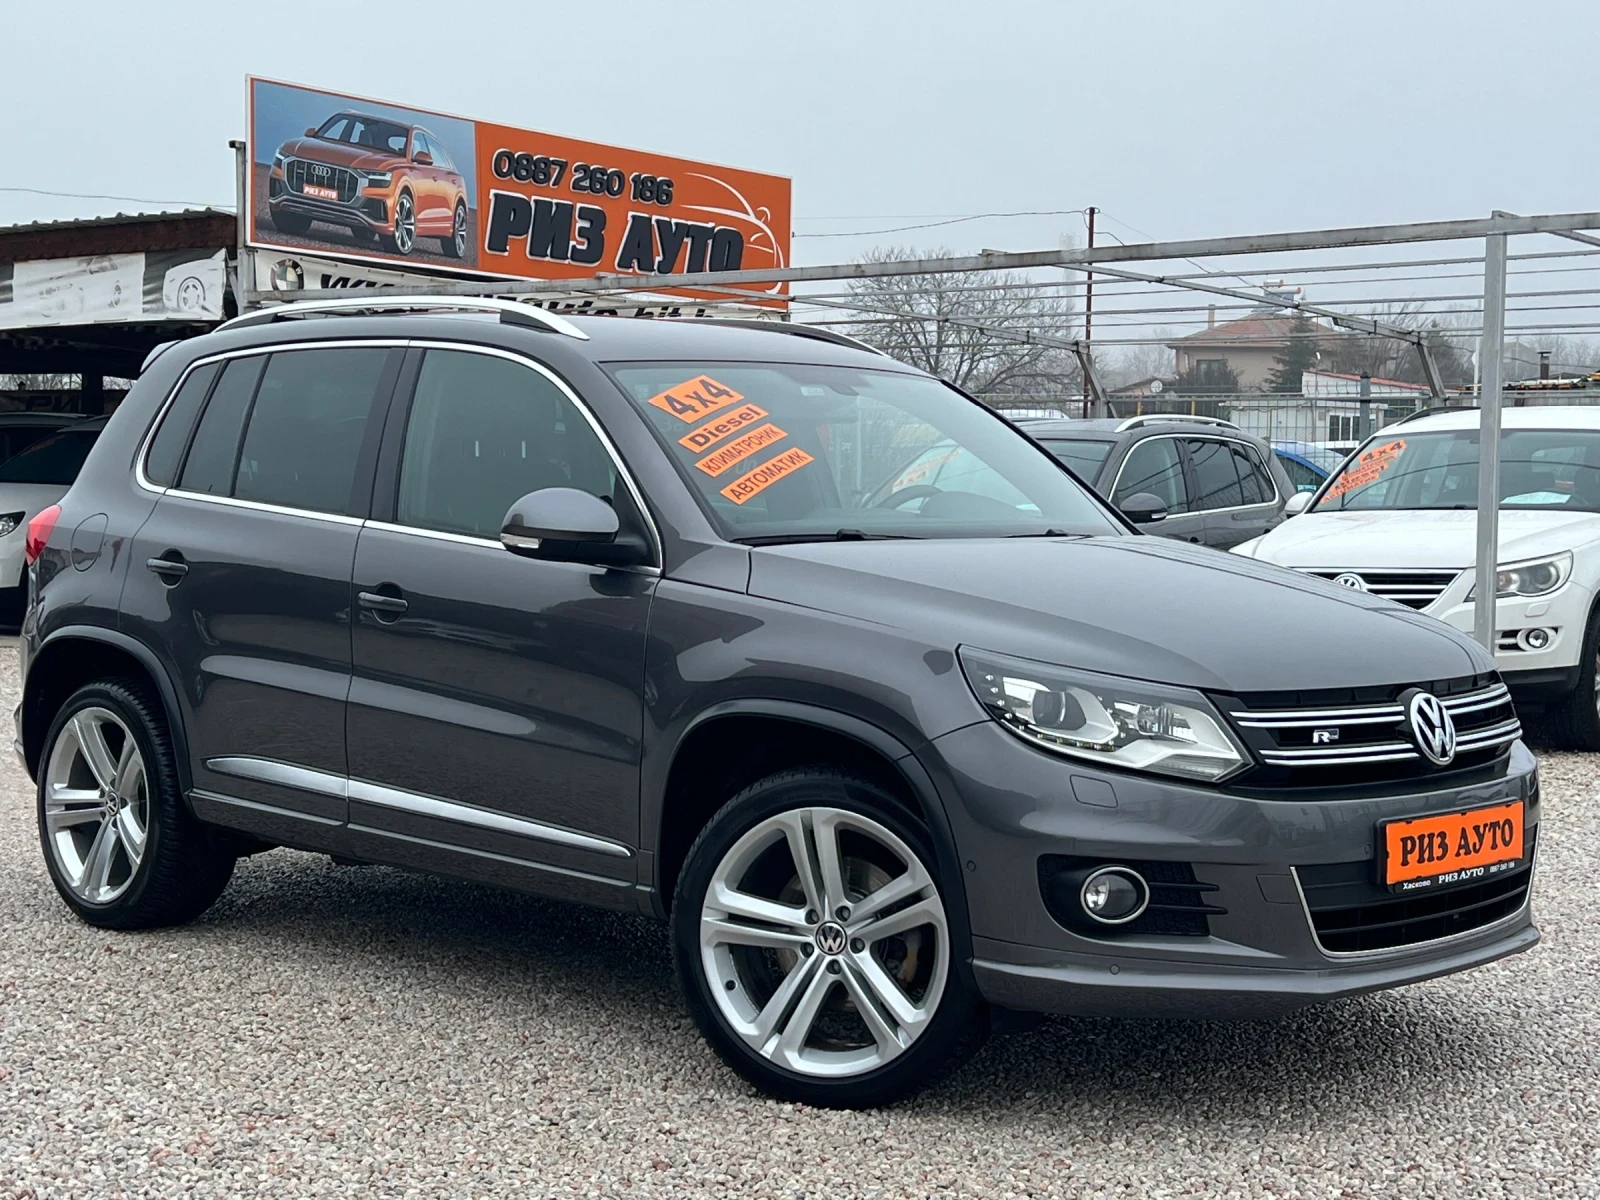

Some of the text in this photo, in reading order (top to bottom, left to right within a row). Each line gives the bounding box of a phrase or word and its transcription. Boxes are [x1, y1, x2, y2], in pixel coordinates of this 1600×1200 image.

[493, 148, 675, 208] 0887 260 186
[484, 189, 745, 275] РИЗ АУТО
[663, 378, 735, 414] 4x4
[688, 406, 762, 447] Diesel
[701, 425, 784, 474] КЛИМАТРОНИК
[729, 450, 808, 500] АВТОМАТИК
[1400, 818, 1515, 867] РИЗ АУТО
[1402, 879, 1432, 890] Хасково
[1438, 873, 1458, 884] РИЗ
[1458, 867, 1485, 880] АУТО
